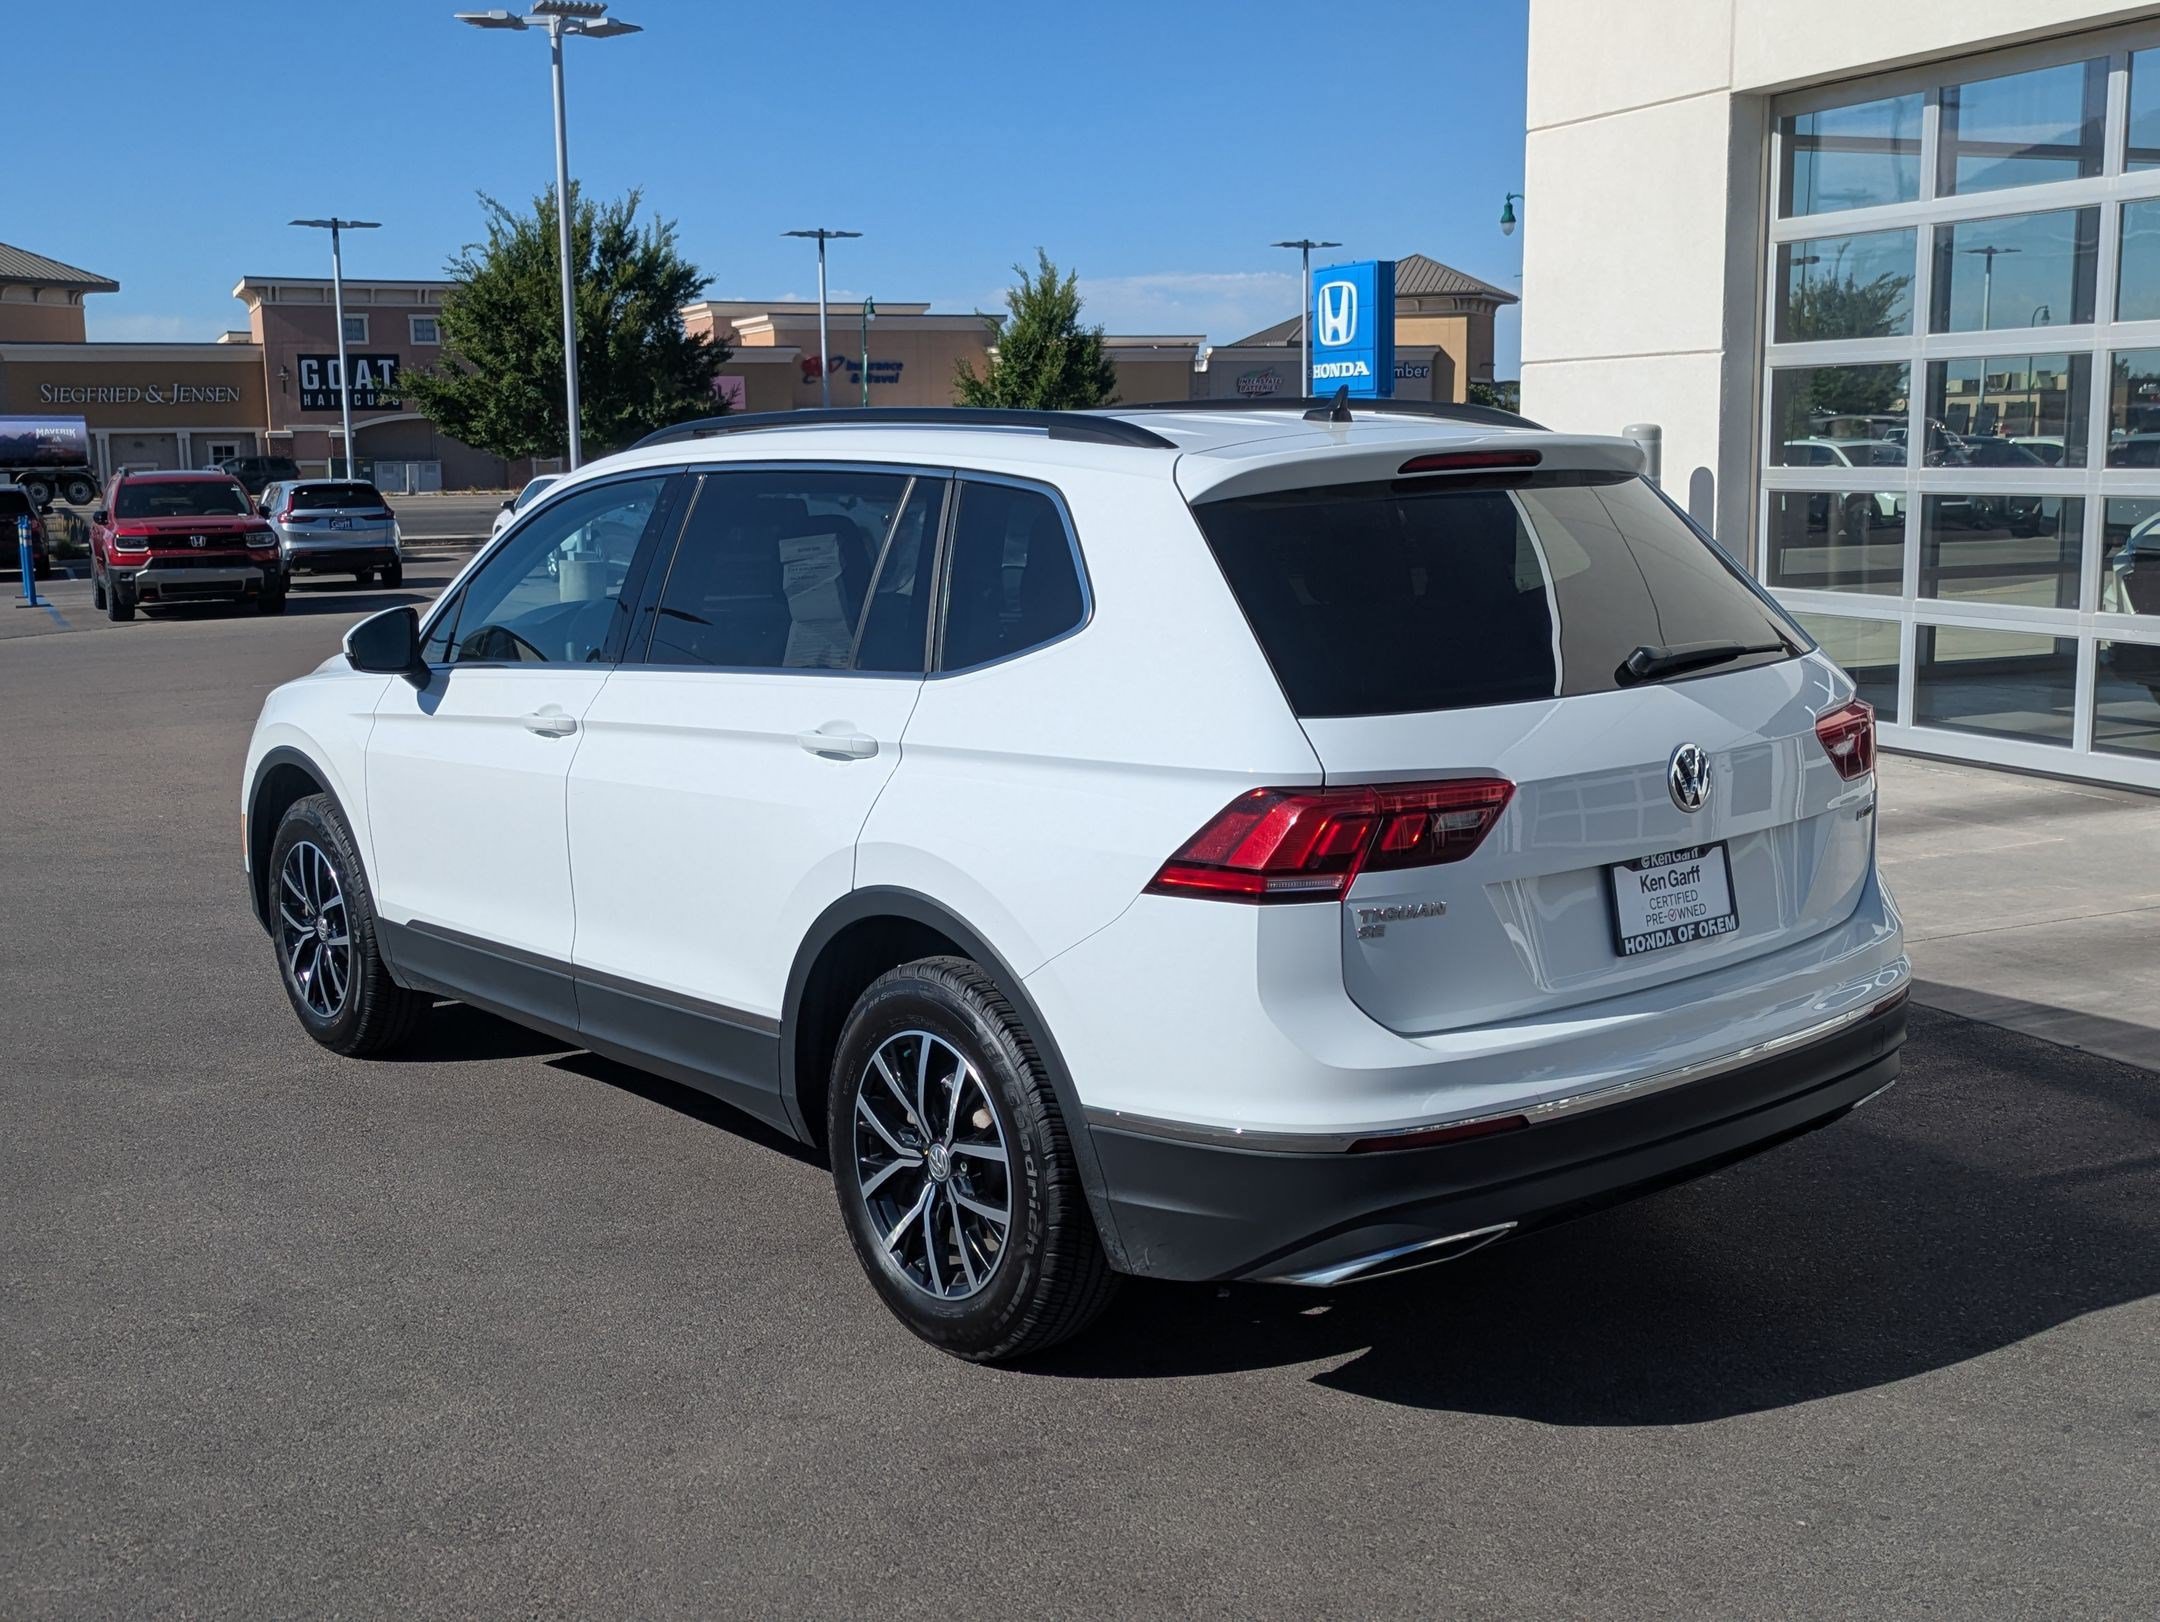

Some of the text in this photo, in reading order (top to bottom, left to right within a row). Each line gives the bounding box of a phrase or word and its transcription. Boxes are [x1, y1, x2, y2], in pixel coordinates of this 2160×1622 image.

[846, 361, 903, 371] Insrance
[1313, 361, 1370, 378] HONDA
[40, 383, 240, 405] SIEGFRIED & JENSEN
[303, 394, 400, 406] HAICUS
[35, 427, 77, 440] MAVERIK
[1640, 865, 1701, 894] Ken Garff
[1649, 889, 1699, 910] CERTIFIED
[1357, 900, 1448, 923] TIGUAN
[1357, 924, 1386, 939] SE
[1624, 930, 1675, 955] HONDA
[1678, 924, 1696, 942] OF
